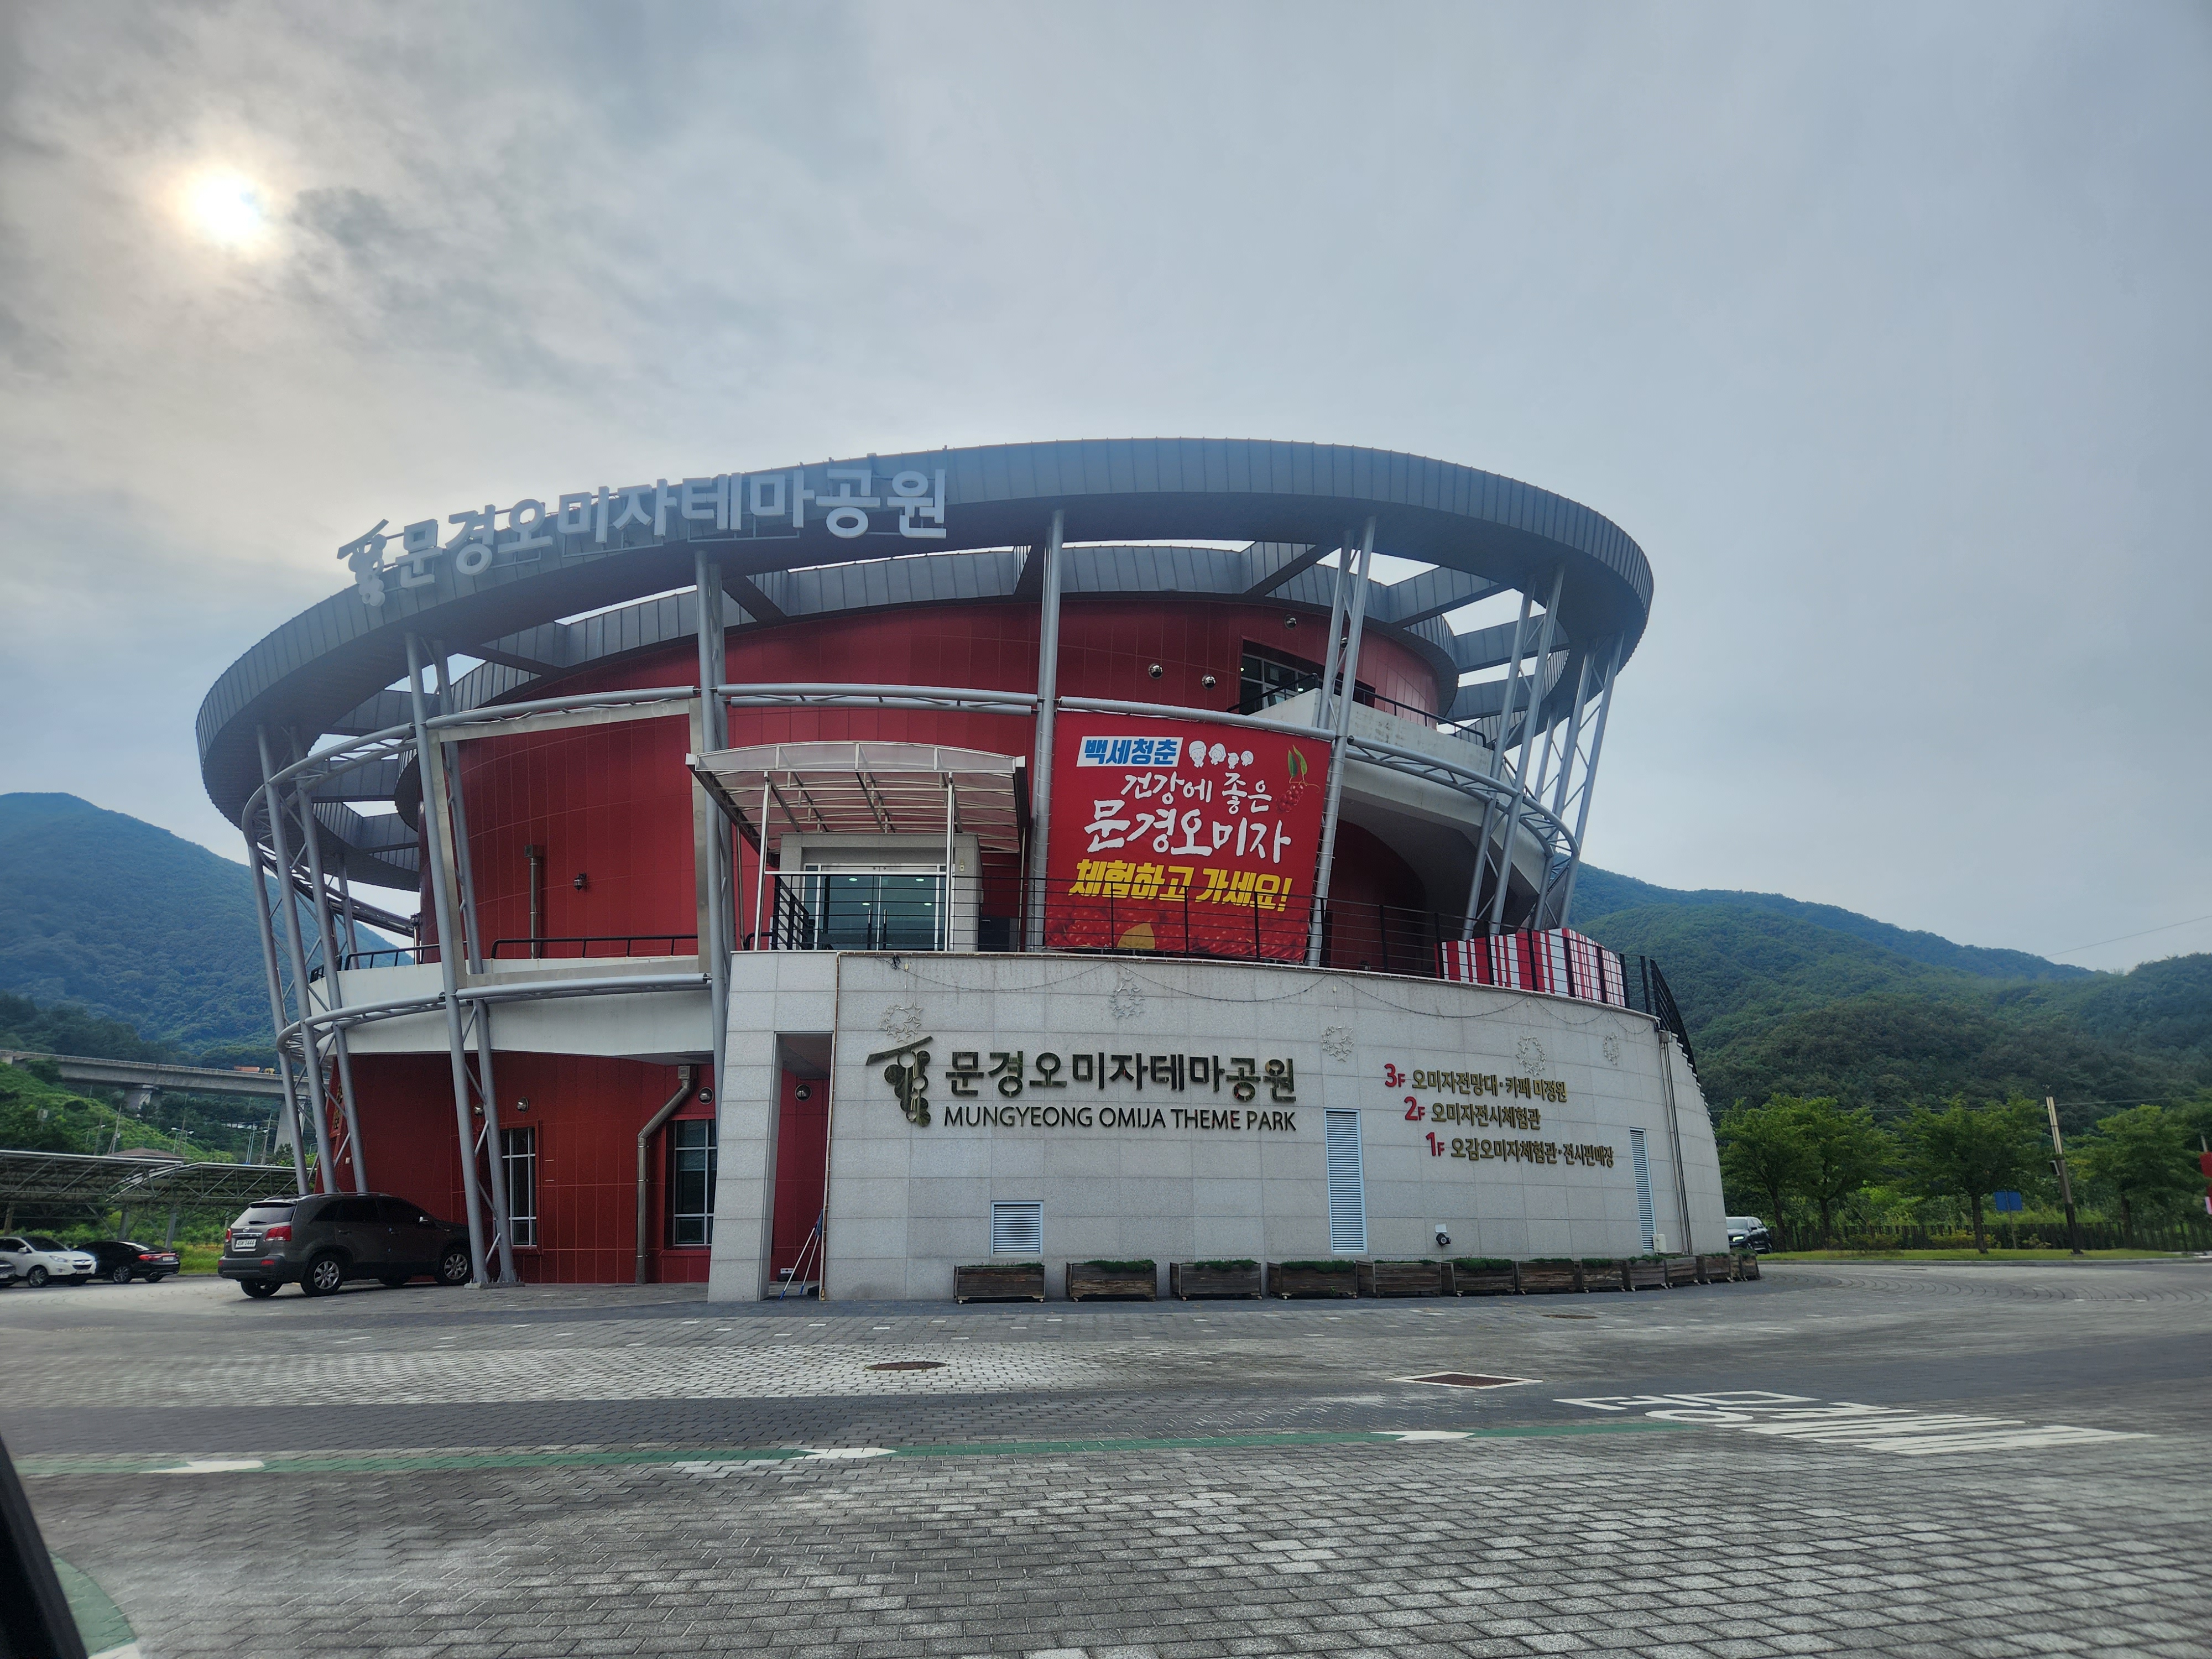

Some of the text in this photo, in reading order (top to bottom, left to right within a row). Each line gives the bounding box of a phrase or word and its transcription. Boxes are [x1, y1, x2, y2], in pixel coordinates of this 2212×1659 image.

[395, 468, 947, 589] 문경오미자테마공원
[1084, 739, 1177, 765] 백세청춘
[1121, 772, 1272, 814] 건강에 좋은
[1084, 800, 1291, 863] 문경오미자
[1068, 859, 1292, 912] 체험하고 가세요!
[945, 1051, 1296, 1102] 문경오미자테마공원
[1384, 1063, 1405, 1087] 3F
[1533, 1079, 1567, 1103] 미정원
[944, 1105, 1296, 1131] MUNGYEONG OMIJA THEME PARK
[1404, 1096, 1541, 1130] 2F 오미자전시체험관
[1426, 1132, 1444, 1156] 1F
[1552, 1390, 2158, 1455] 문경새재
